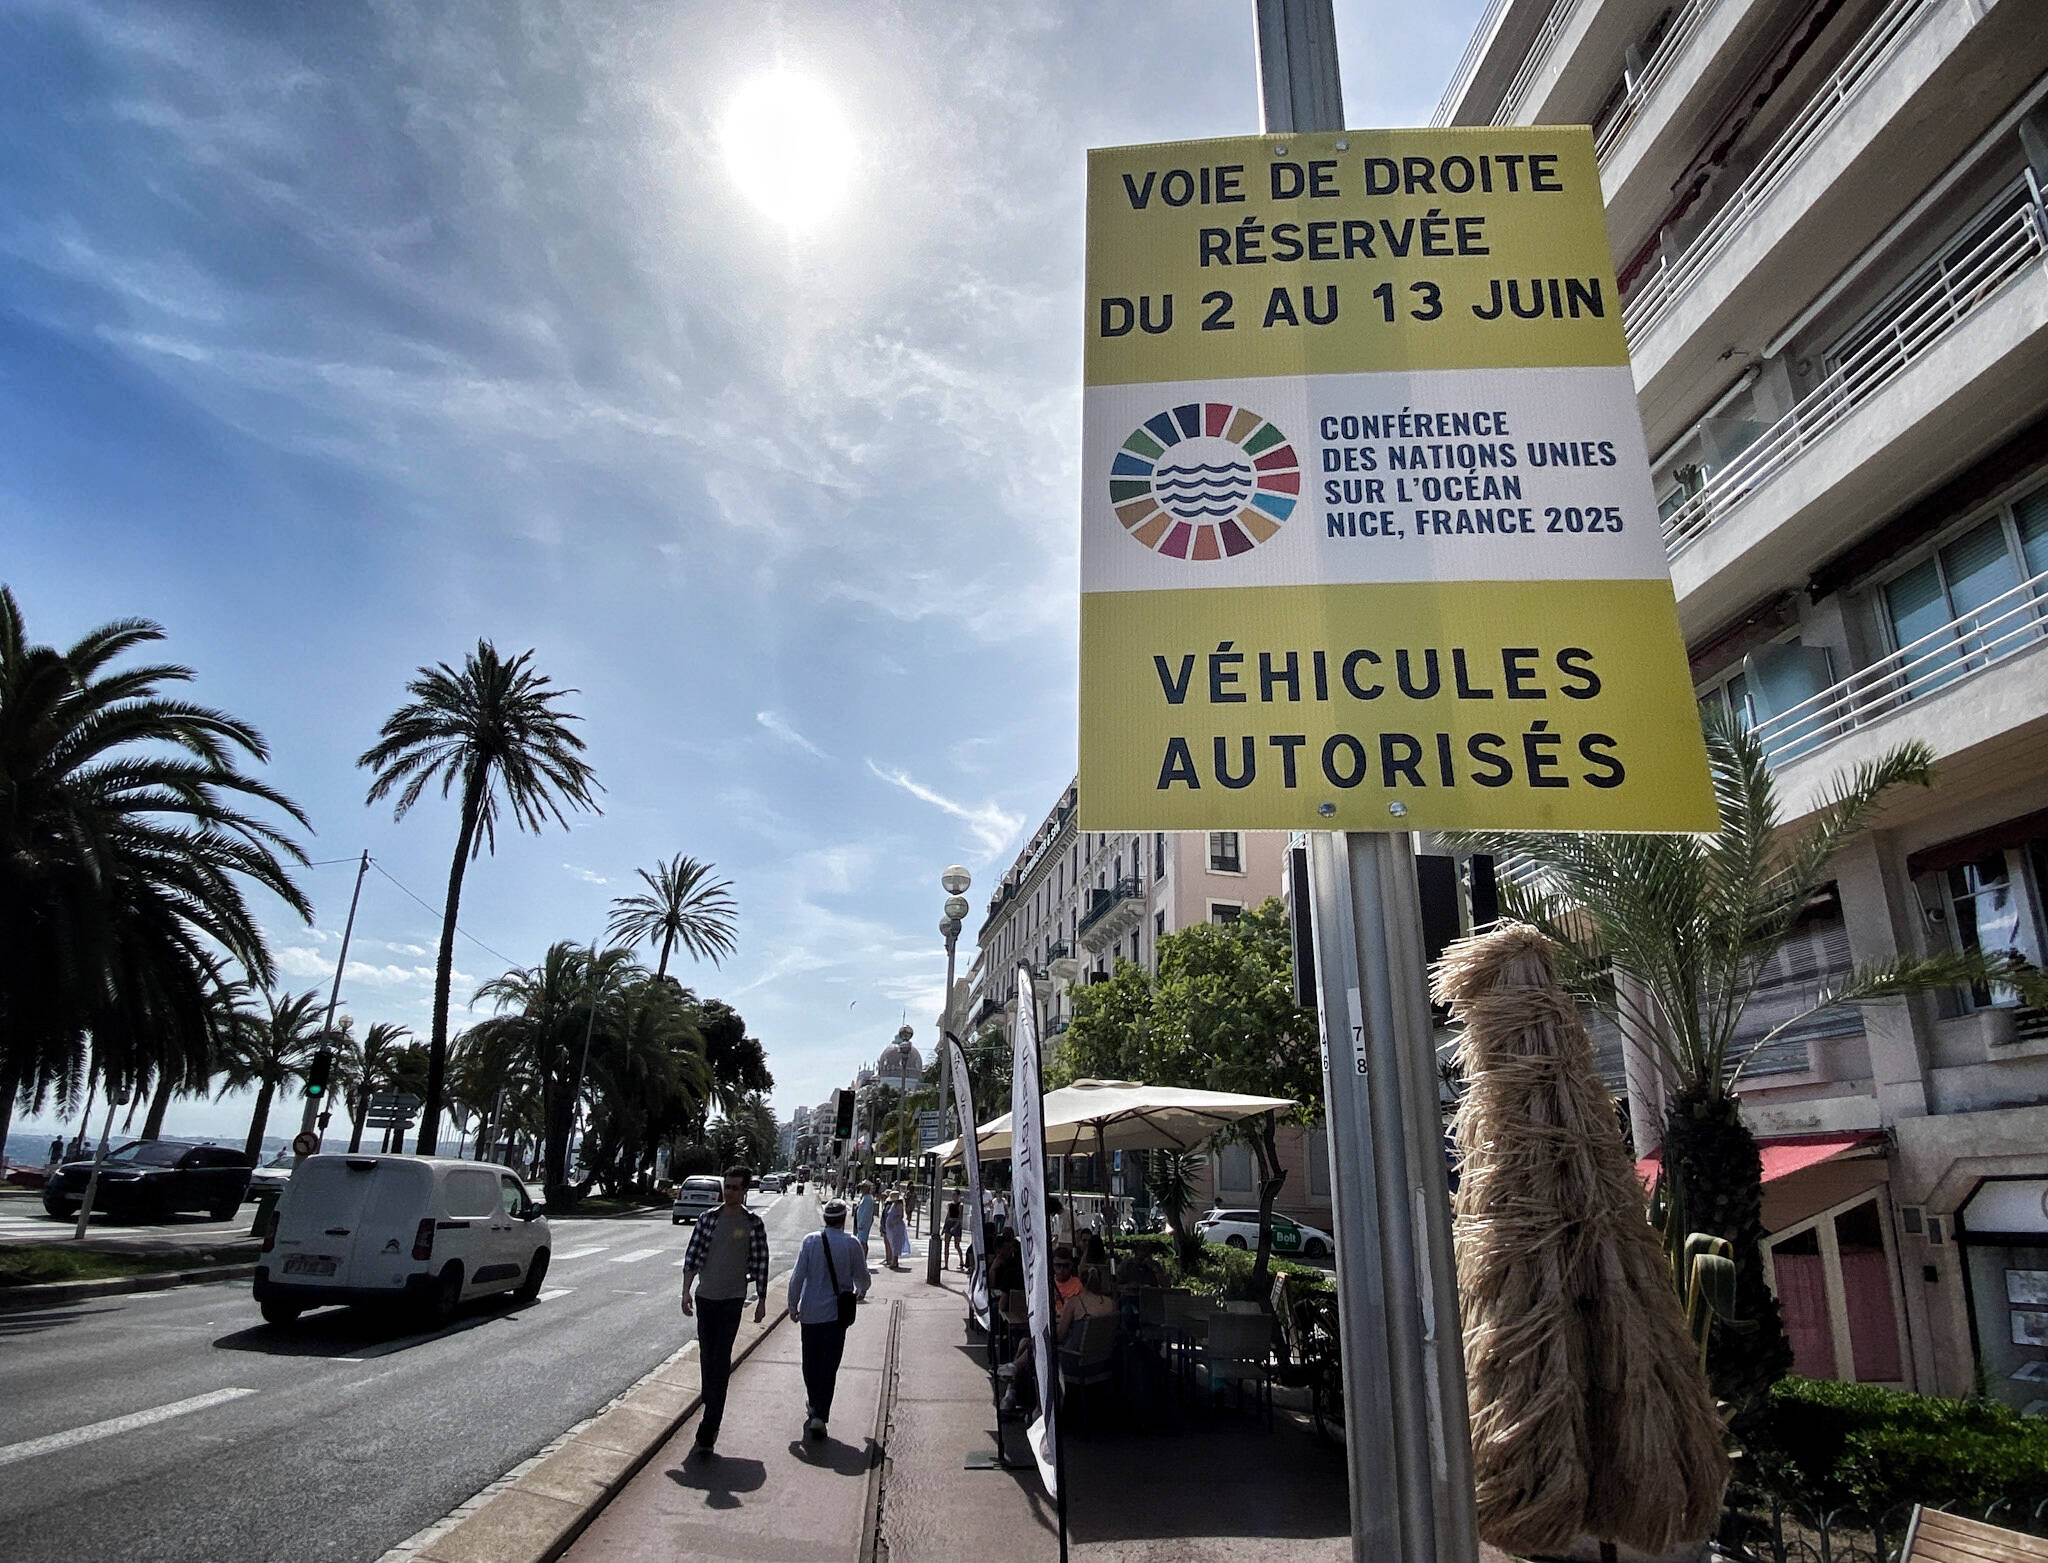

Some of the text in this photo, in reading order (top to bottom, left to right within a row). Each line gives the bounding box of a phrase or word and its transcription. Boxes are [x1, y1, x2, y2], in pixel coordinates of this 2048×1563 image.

[1122, 155, 1563, 209] VOIE DE DROITE
[1200, 209, 1489, 267] RÉSERVÉE
[1101, 278, 1604, 337] DU 2 AU 13 JUIN
[1321, 407, 1509, 440] CONFÉRENCE
[1323, 442, 1616, 472] DES NATIONS UNIES
[1325, 479, 1385, 504] SUR
[1327, 507, 1623, 539] NICE, FRANCE 2025
[1154, 641, 1601, 704] VÉHICULES
[1157, 720, 1625, 789] AUTORISÉS
[1276, 1231, 1297, 1243] Bolt
